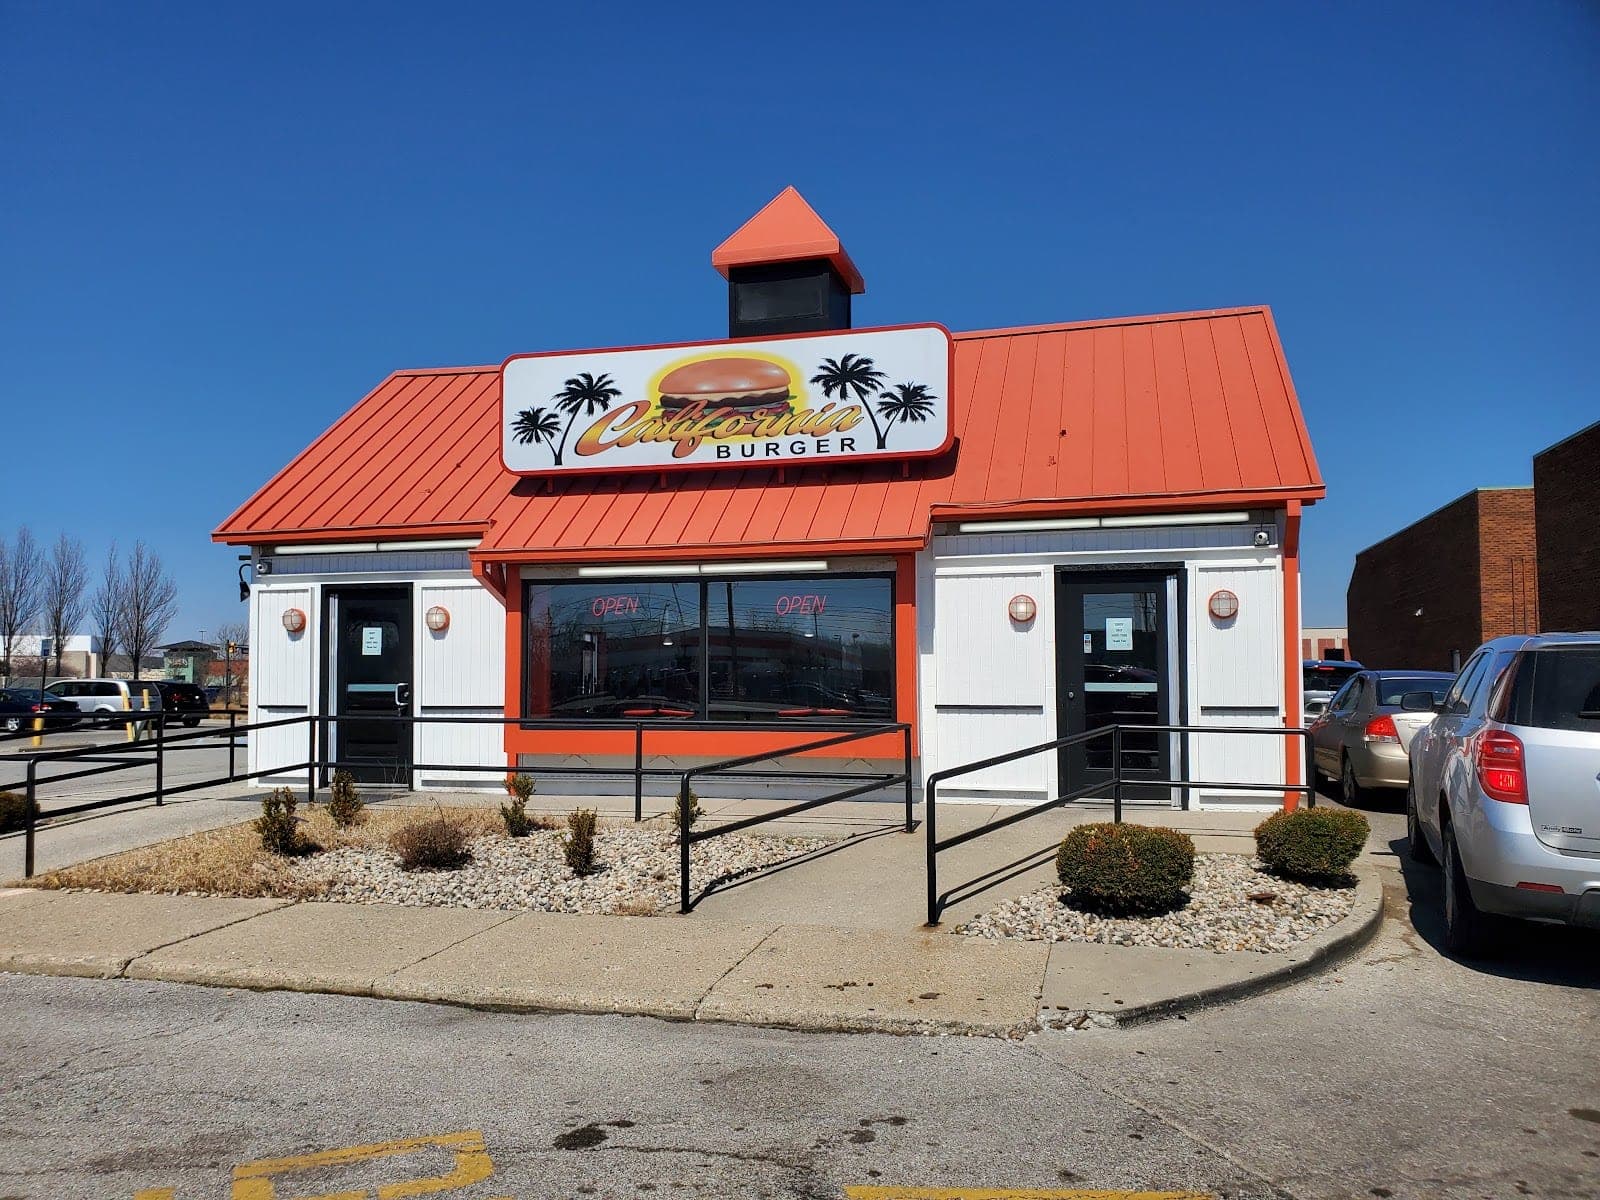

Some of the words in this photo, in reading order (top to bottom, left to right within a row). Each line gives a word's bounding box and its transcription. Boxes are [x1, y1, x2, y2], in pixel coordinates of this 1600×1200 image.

[574, 399, 865, 458] California
[716, 437, 857, 459] BURGER
[592, 596, 639, 617] OPEN
[776, 595, 827, 615] OPEN
